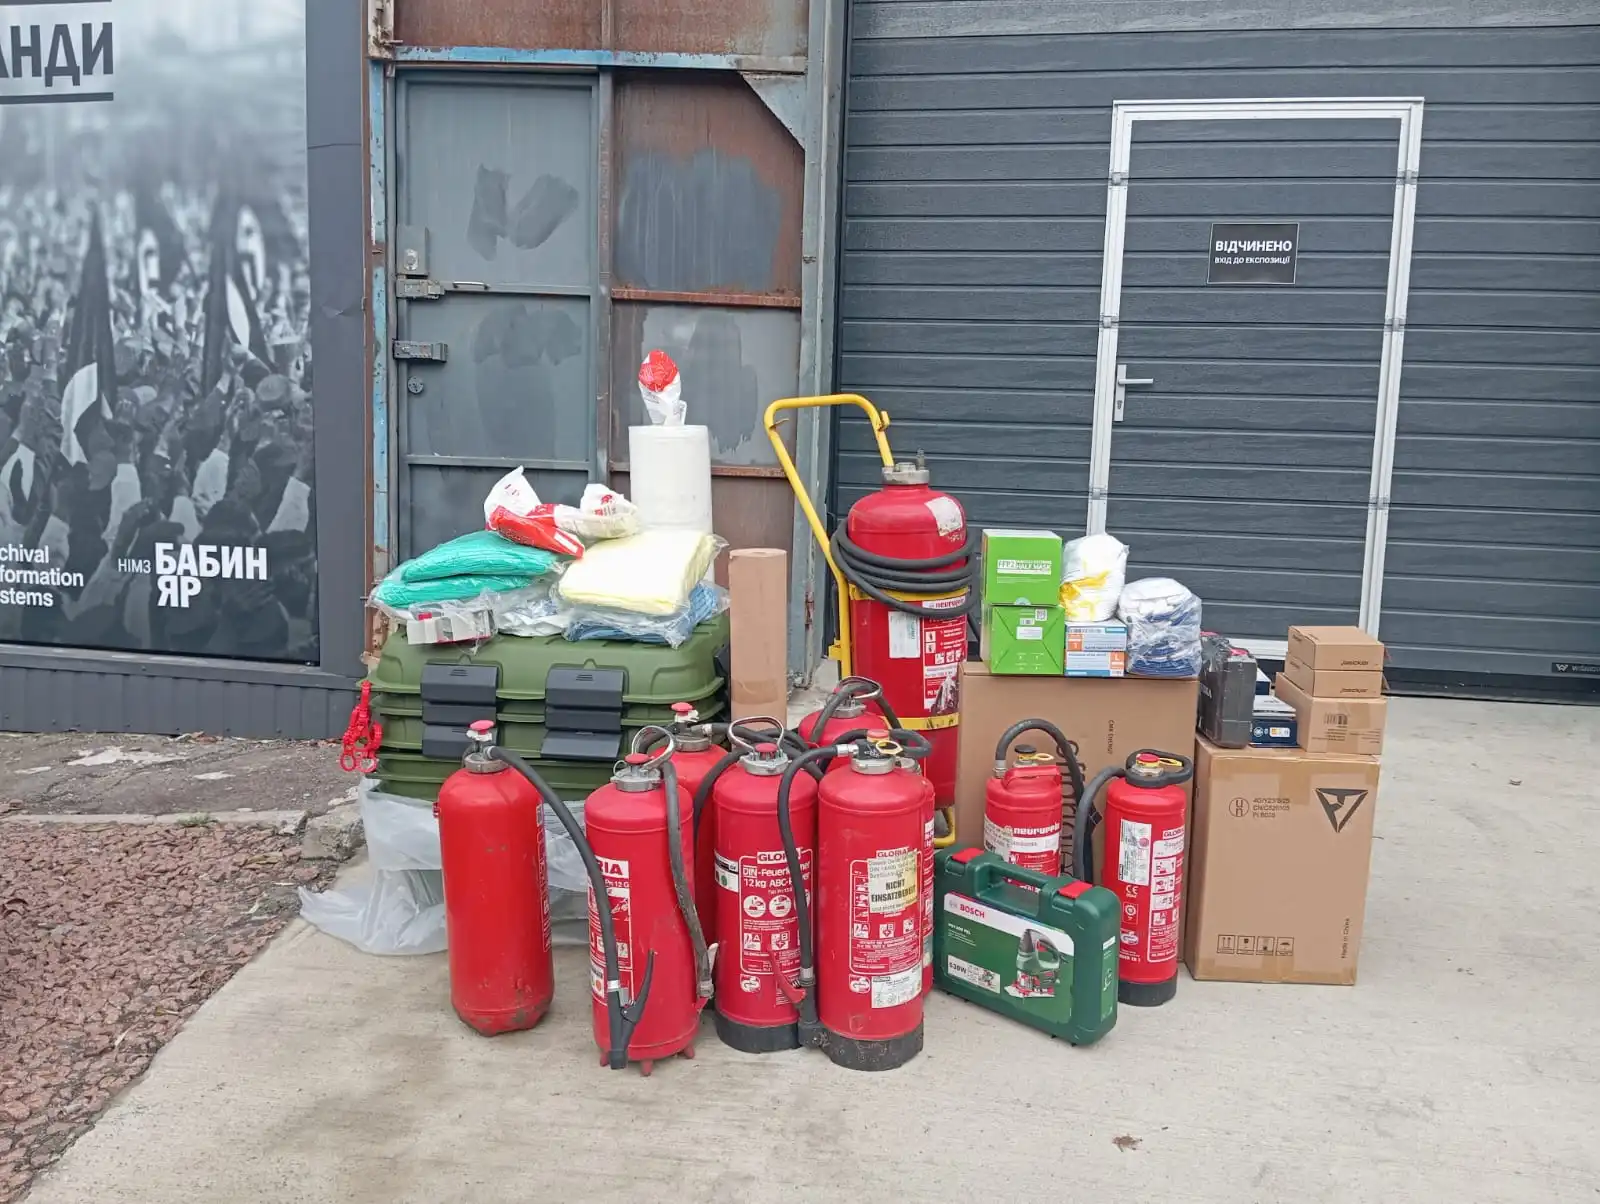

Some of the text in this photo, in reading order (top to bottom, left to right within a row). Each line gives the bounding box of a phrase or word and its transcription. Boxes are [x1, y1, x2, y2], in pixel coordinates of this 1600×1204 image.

[0, 22, 113, 87] НДИ
[1215, 240, 1293, 254] ВІДЧИНЕНО
[1214, 256, 1291, 265] ВХІД ДО ЕКСПОЗИЦІЇ
[155, 542, 268, 580] БАБИН
[157, 575, 202, 608] ЯР
[877, 848, 909, 858] GLORIA
[885, 879, 906, 890] NICHT
[871, 885, 916, 902] EINSATZBEREIT
[959, 903, 985, 918] BOSCH
